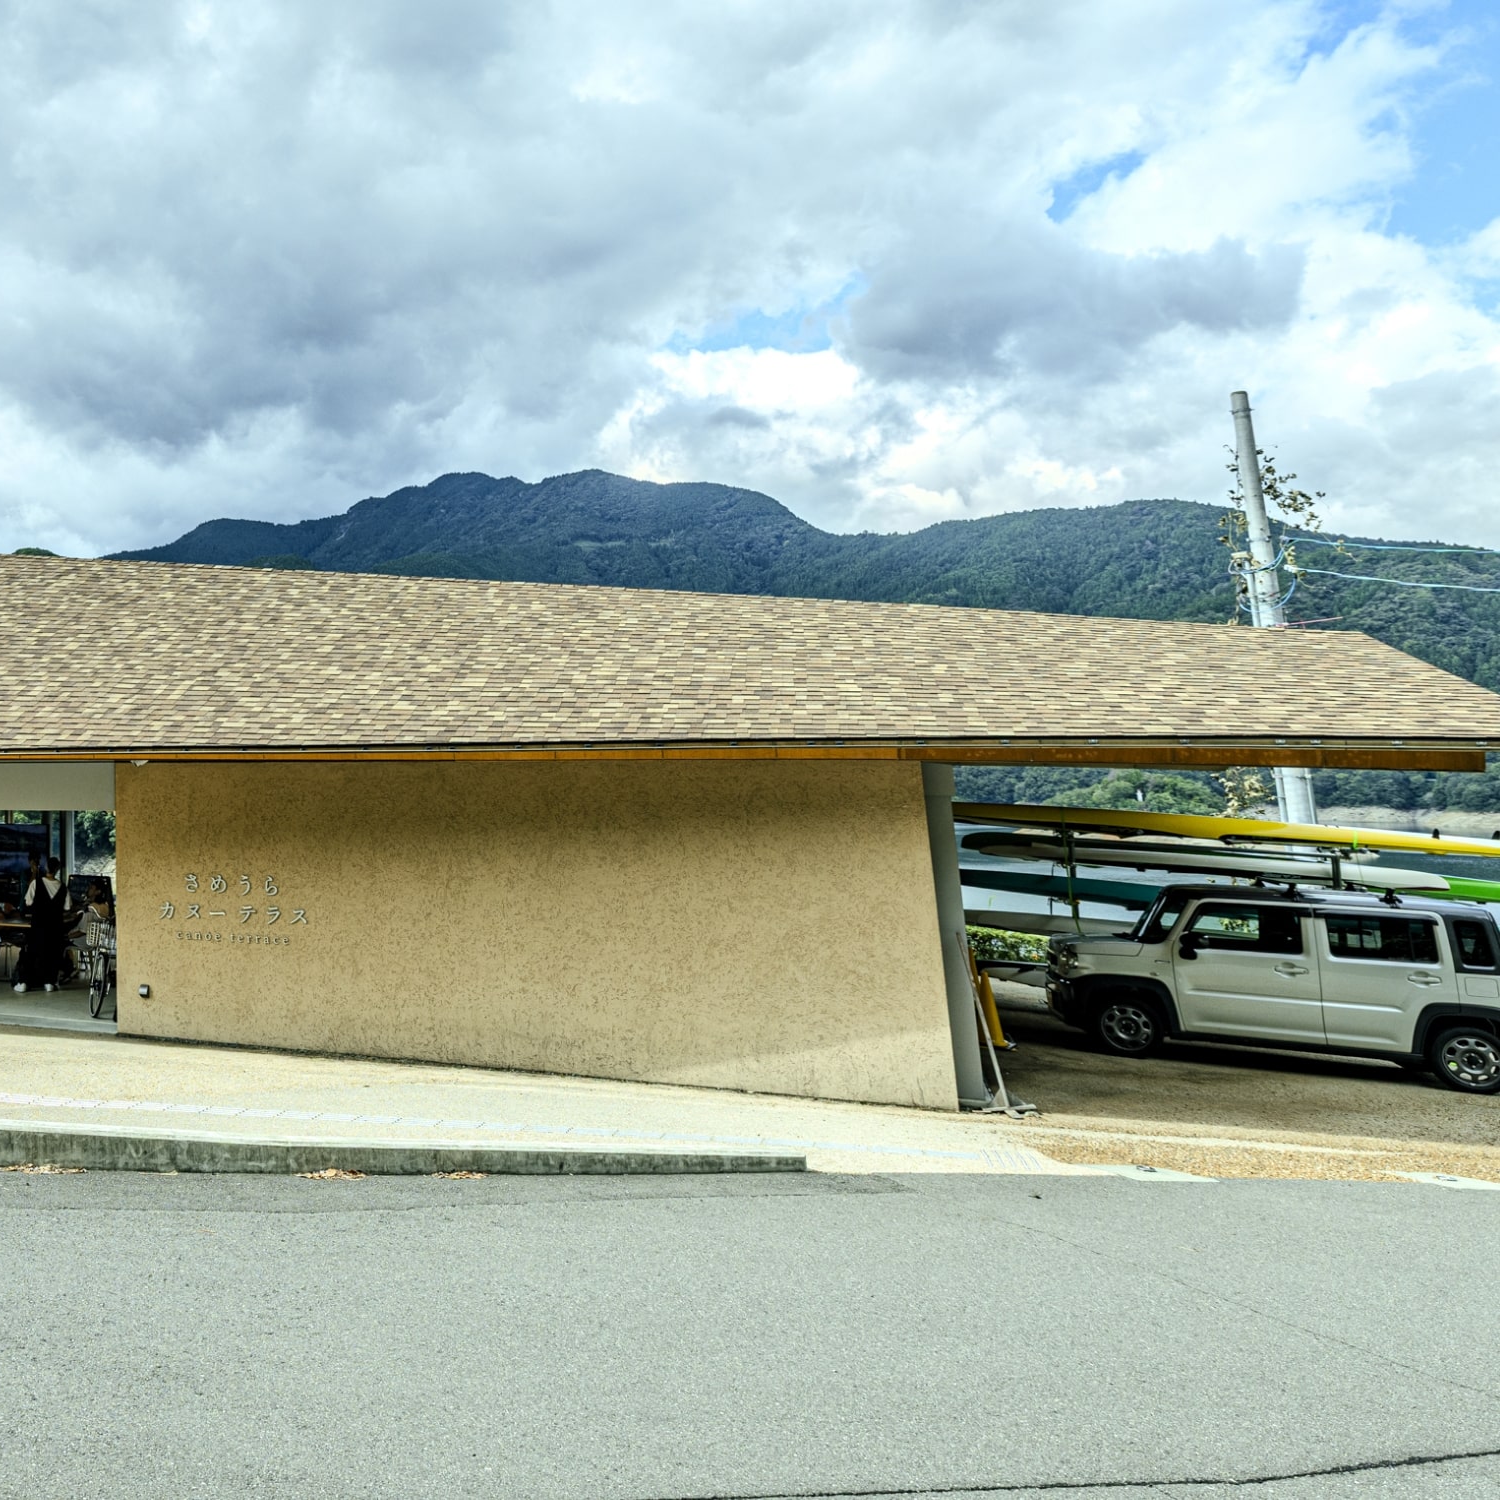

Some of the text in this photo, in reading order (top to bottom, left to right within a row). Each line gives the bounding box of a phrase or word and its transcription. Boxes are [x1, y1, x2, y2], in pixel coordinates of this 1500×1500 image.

[184, 873, 278, 896] さめうら
[176, 931, 290, 945] canoe terrace
